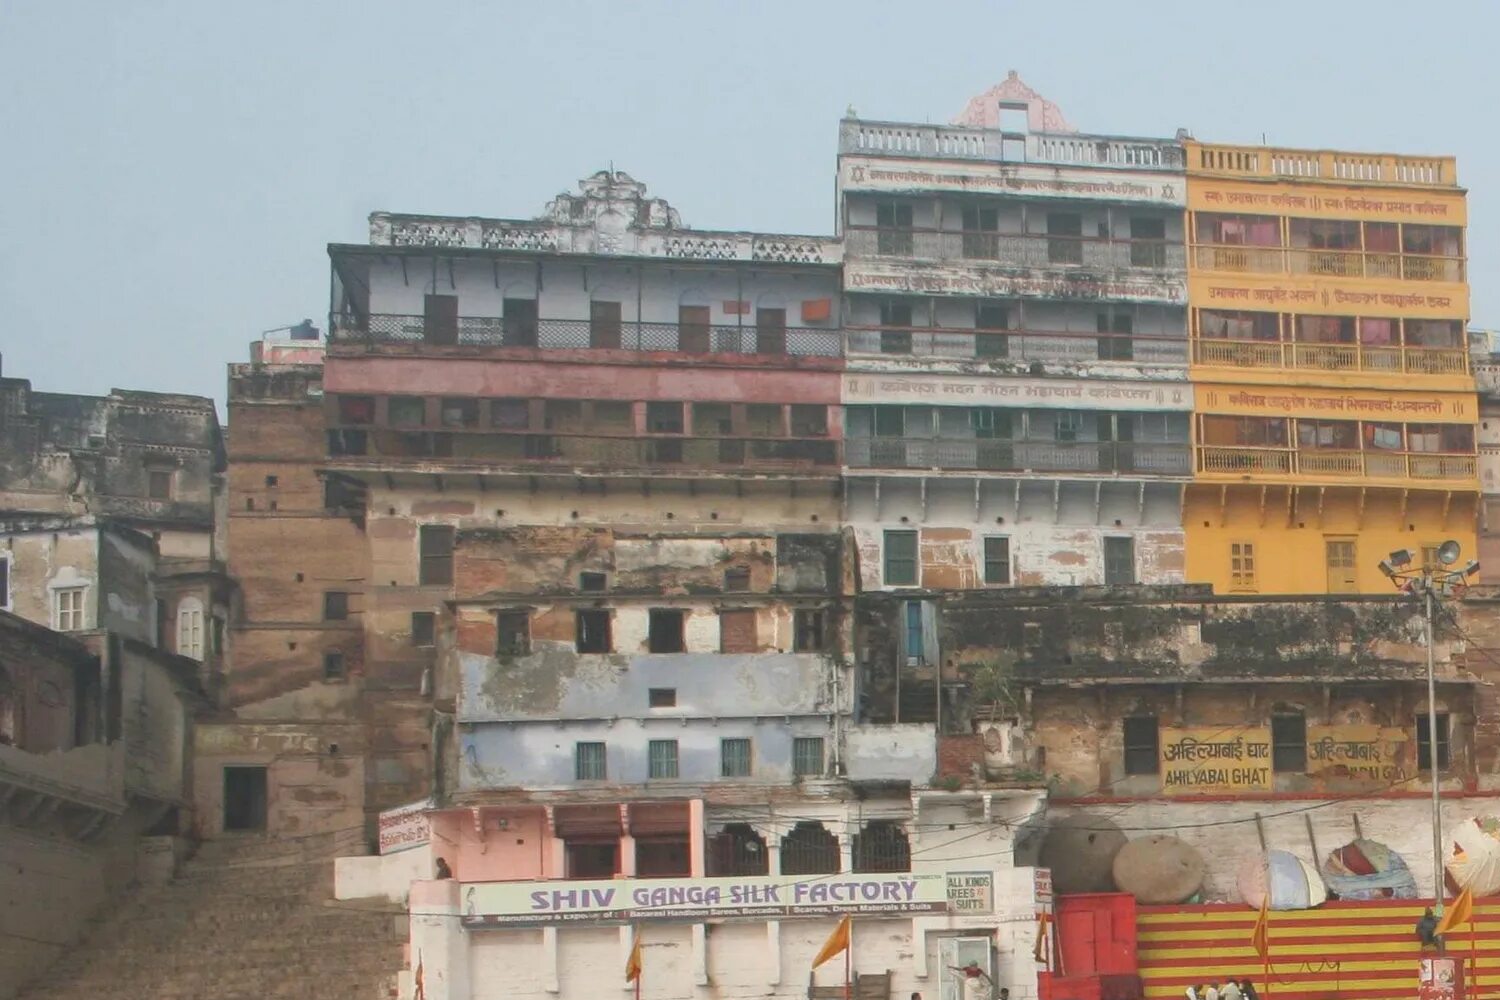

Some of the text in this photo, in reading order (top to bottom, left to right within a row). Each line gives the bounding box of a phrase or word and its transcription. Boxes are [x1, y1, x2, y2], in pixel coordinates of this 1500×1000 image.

[1164, 736, 1269, 762] अहिल्याबाई घाट
[1165, 767, 1269, 786] AHILYABAI GHAT
[947, 876, 963, 888] ALL
[531, 880, 919, 911] SHIV GANGA SILK FACTORY
[946, 888, 976, 899] AREES
[630, 909, 666, 918] Banarasi
[667, 908, 709, 917] Handloom
[793, 905, 831, 914] Scarves,
[860, 902, 899, 912] Materials
[908, 902, 932, 911] Suits
[956, 899, 984, 910] SUITS
